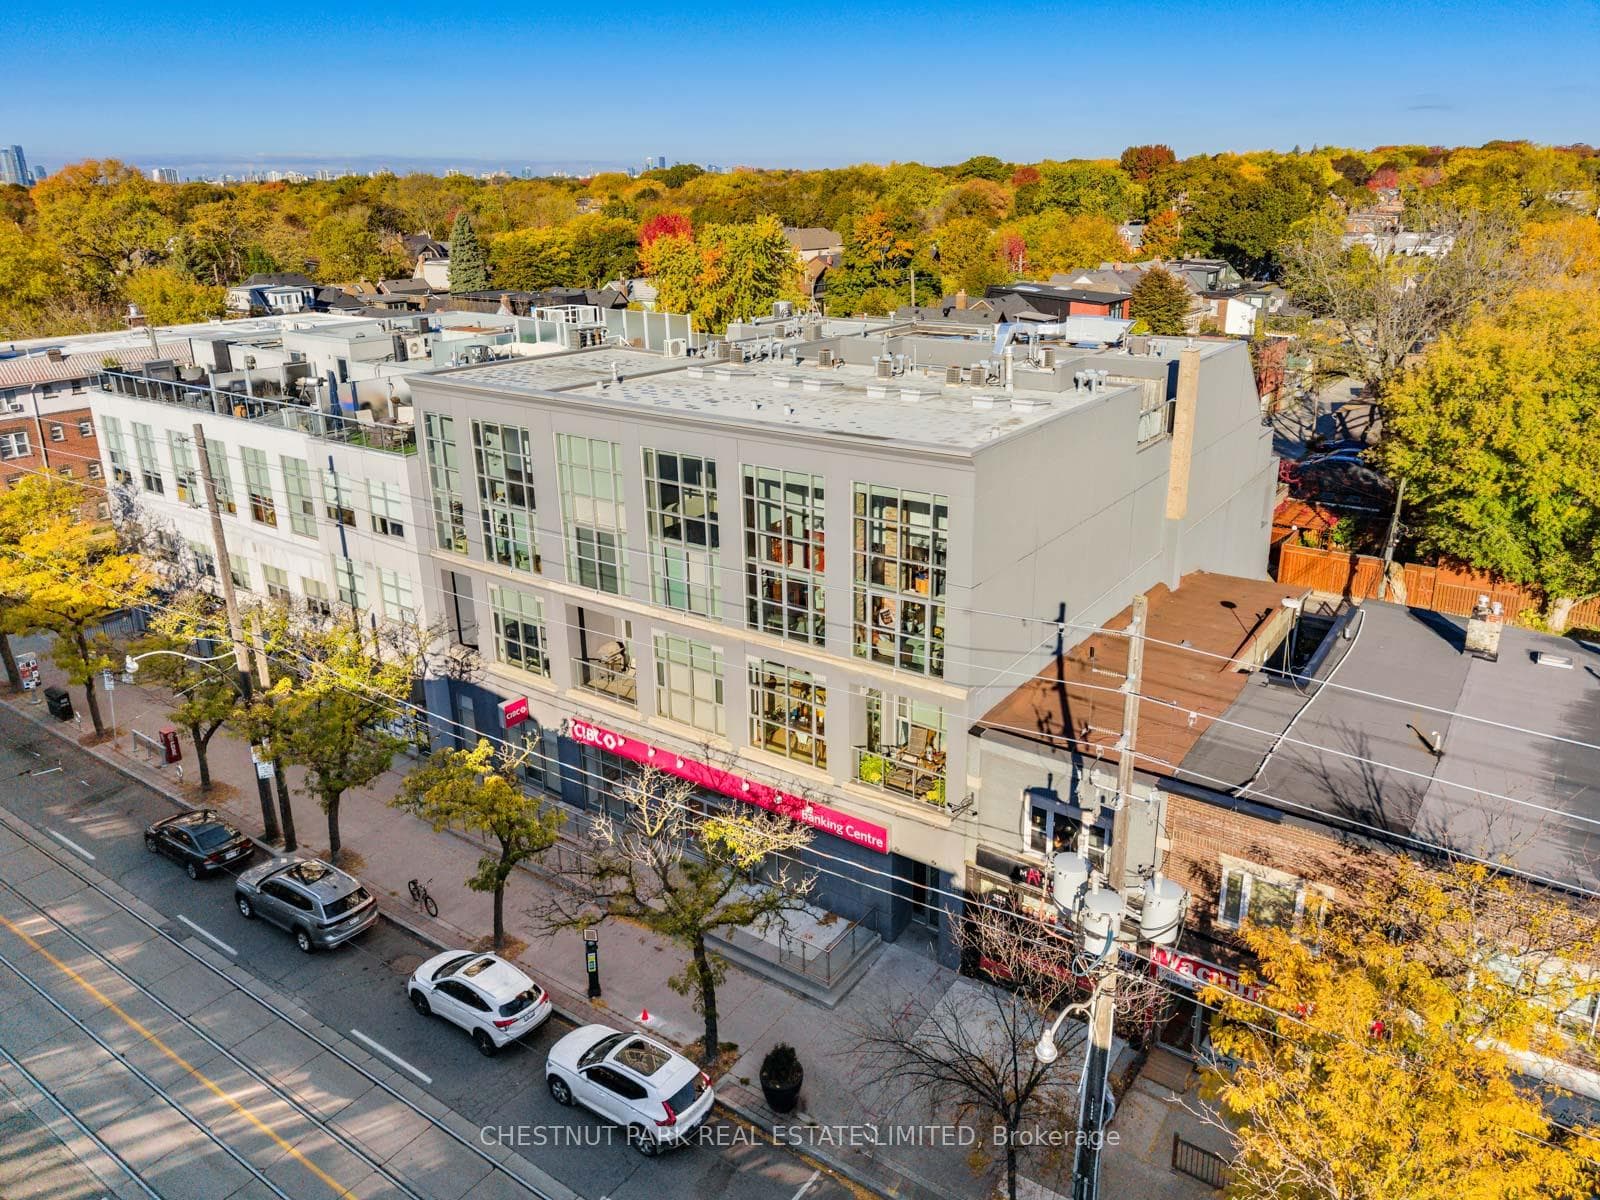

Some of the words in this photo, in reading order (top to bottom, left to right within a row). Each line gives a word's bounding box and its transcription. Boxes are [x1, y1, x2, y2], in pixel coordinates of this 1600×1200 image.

[506, 708, 521, 720] CIBC
[574, 724, 604, 745] CIBC
[801, 810, 844, 836] Banking
[845, 825, 884, 848] Centre
